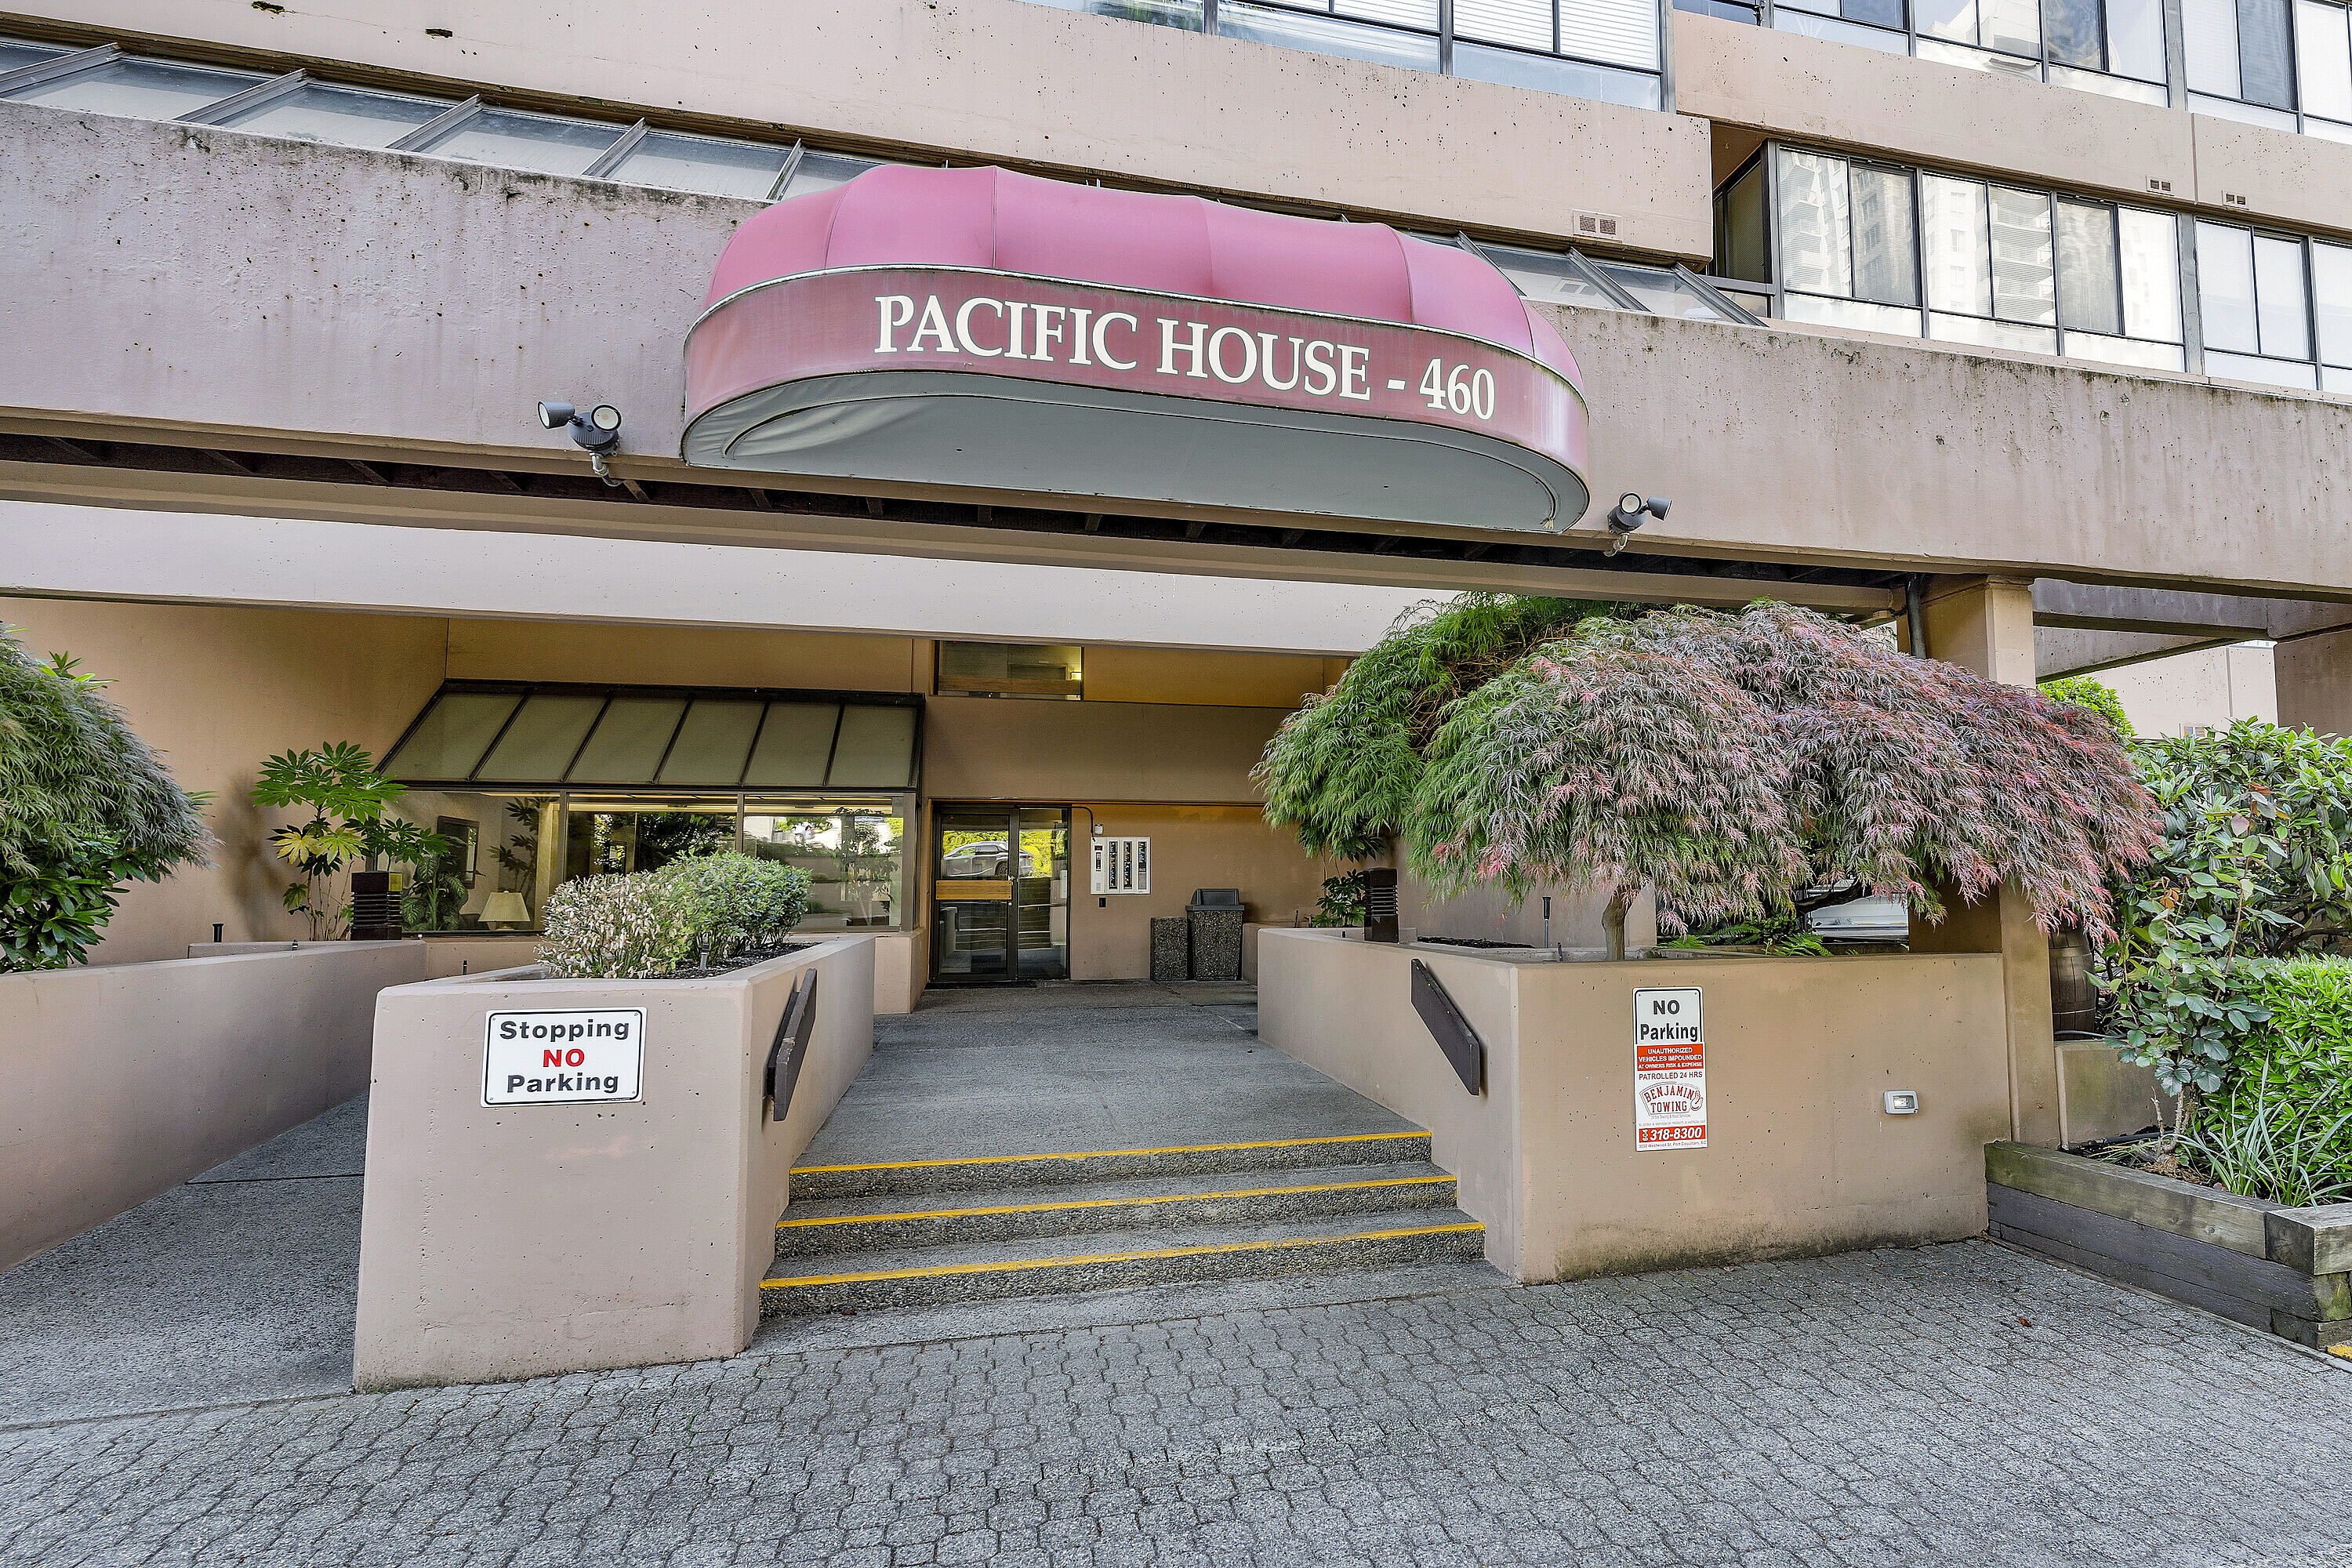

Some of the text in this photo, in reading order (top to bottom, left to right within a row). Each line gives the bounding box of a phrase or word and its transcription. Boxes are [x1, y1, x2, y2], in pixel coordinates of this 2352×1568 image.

[873, 293, 1496, 421] PACIFIC HOUSE - 460
[1653, 1000, 1680, 1014] NO
[499, 1018, 630, 1042] Stopping
[1640, 1022, 1698, 1042] Parking
[543, 1048, 585, 1068] NO
[506, 1072, 619, 1094] Parking
[1639, 1072, 1679, 1080] PATROLLED
[1643, 1085, 1694, 1102] BENJAMIN
[1650, 1101, 1687, 1112] TOWING
[1650, 1127, 1702, 1141] 318-8300
